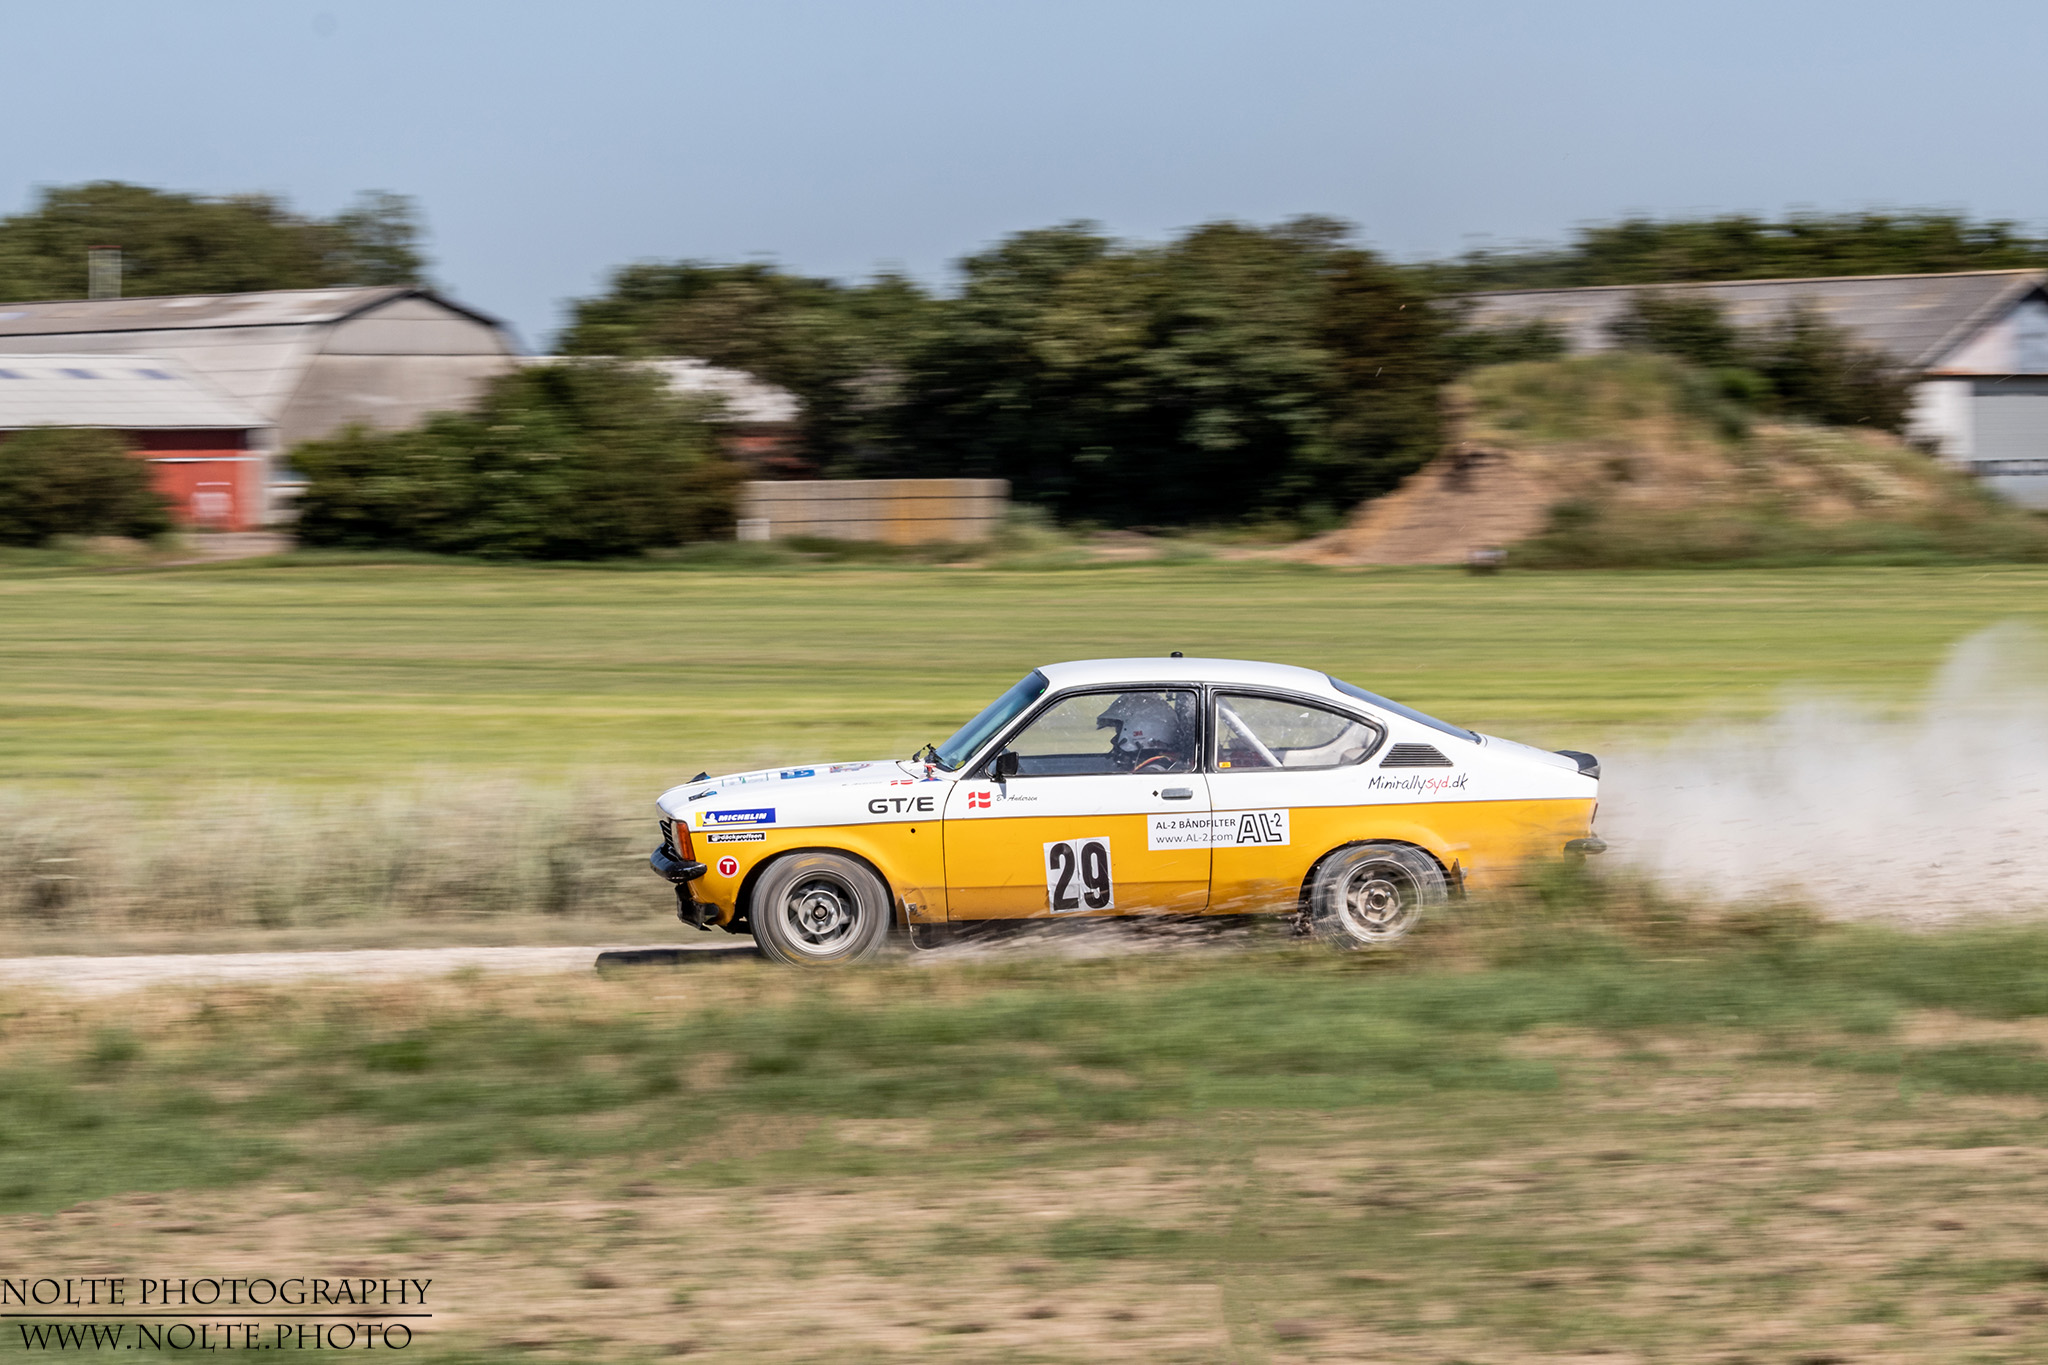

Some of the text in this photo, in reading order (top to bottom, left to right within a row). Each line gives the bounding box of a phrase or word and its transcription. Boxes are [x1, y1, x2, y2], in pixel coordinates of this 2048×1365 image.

[1367, 772, 1469, 795] Minirallysyd.dk
[1007, 794, 1038, 802] Andersen
[867, 796, 935, 814] GT/E
[717, 812, 768, 822] MICHELIN
[1155, 820, 1177, 830] AL-2
[1156, 832, 1234, 843] www.AL-2.com
[722, 861, 735, 874] T
[1049, 841, 1110, 910] 29
